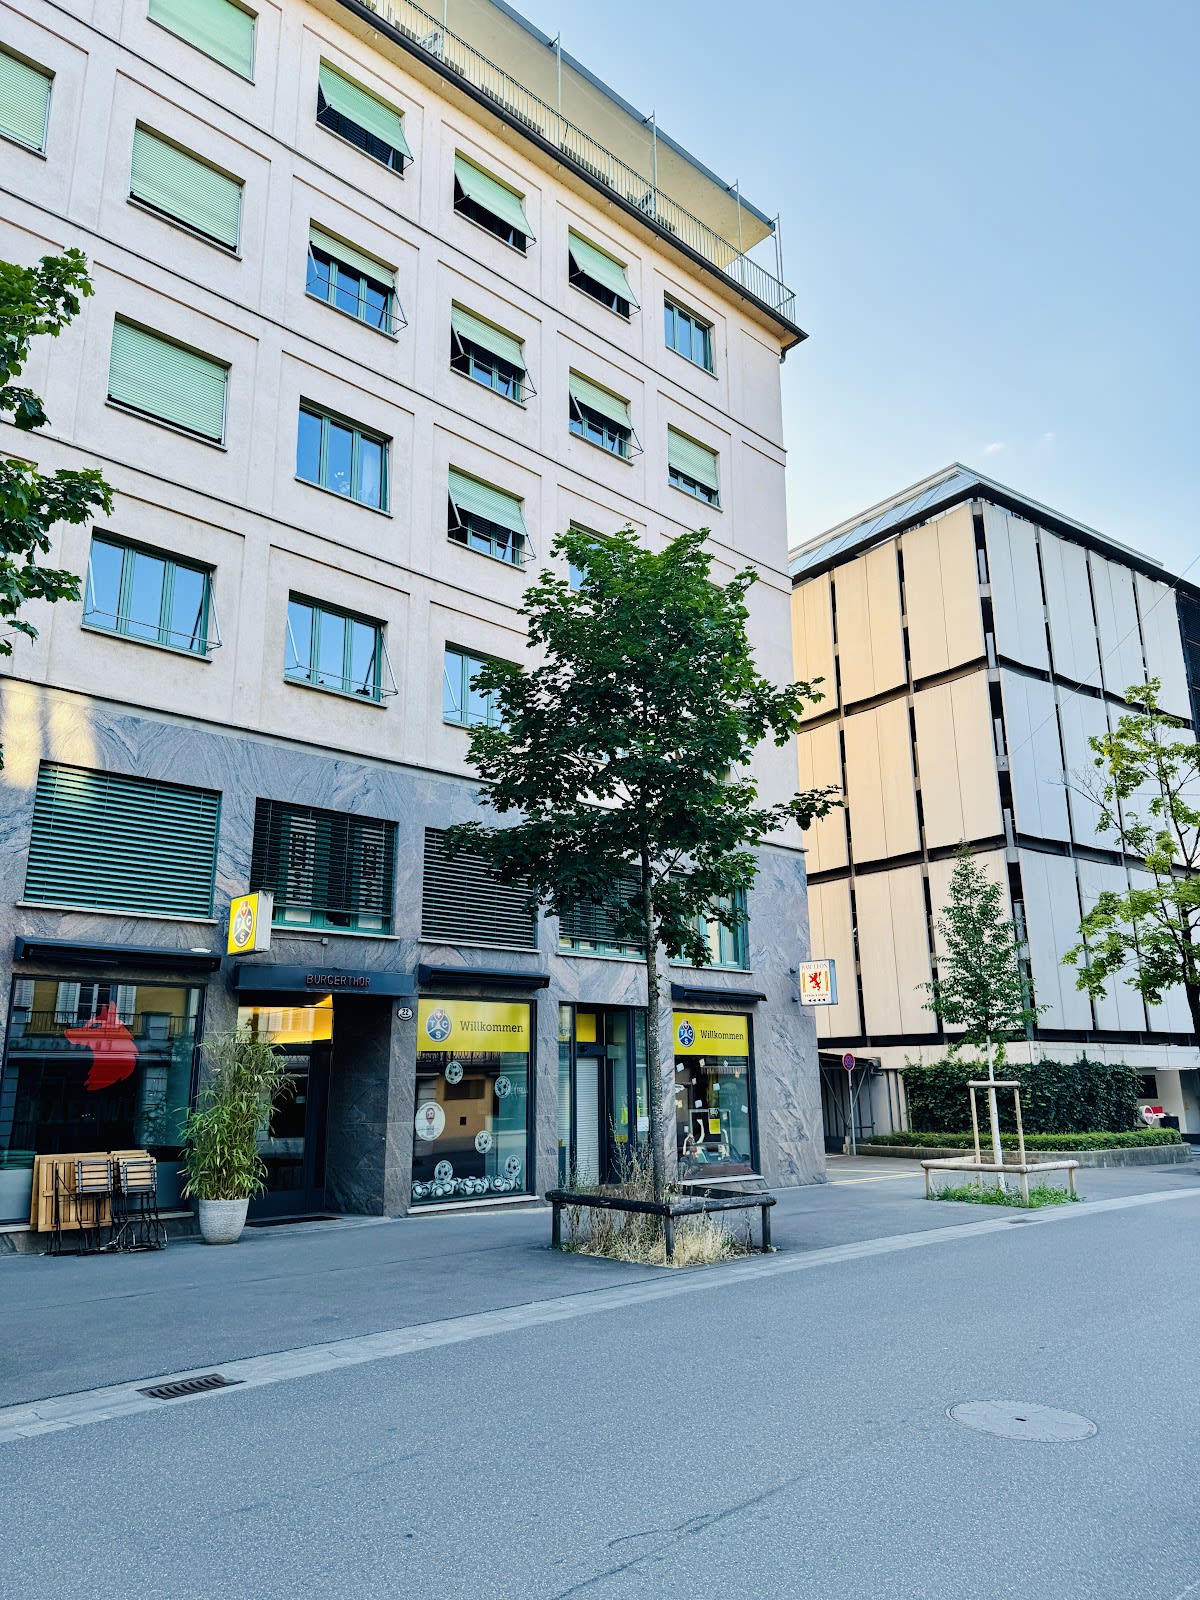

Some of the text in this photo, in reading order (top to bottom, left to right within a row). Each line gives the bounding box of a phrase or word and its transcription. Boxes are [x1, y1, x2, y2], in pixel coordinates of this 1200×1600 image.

[306, 974, 371, 987] BURGERTHOR
[402, 1008, 409, 1016] 22
[430, 1020, 524, 1039] TCS Willkommen
[679, 1028, 744, 1045] TCS Willkommen
